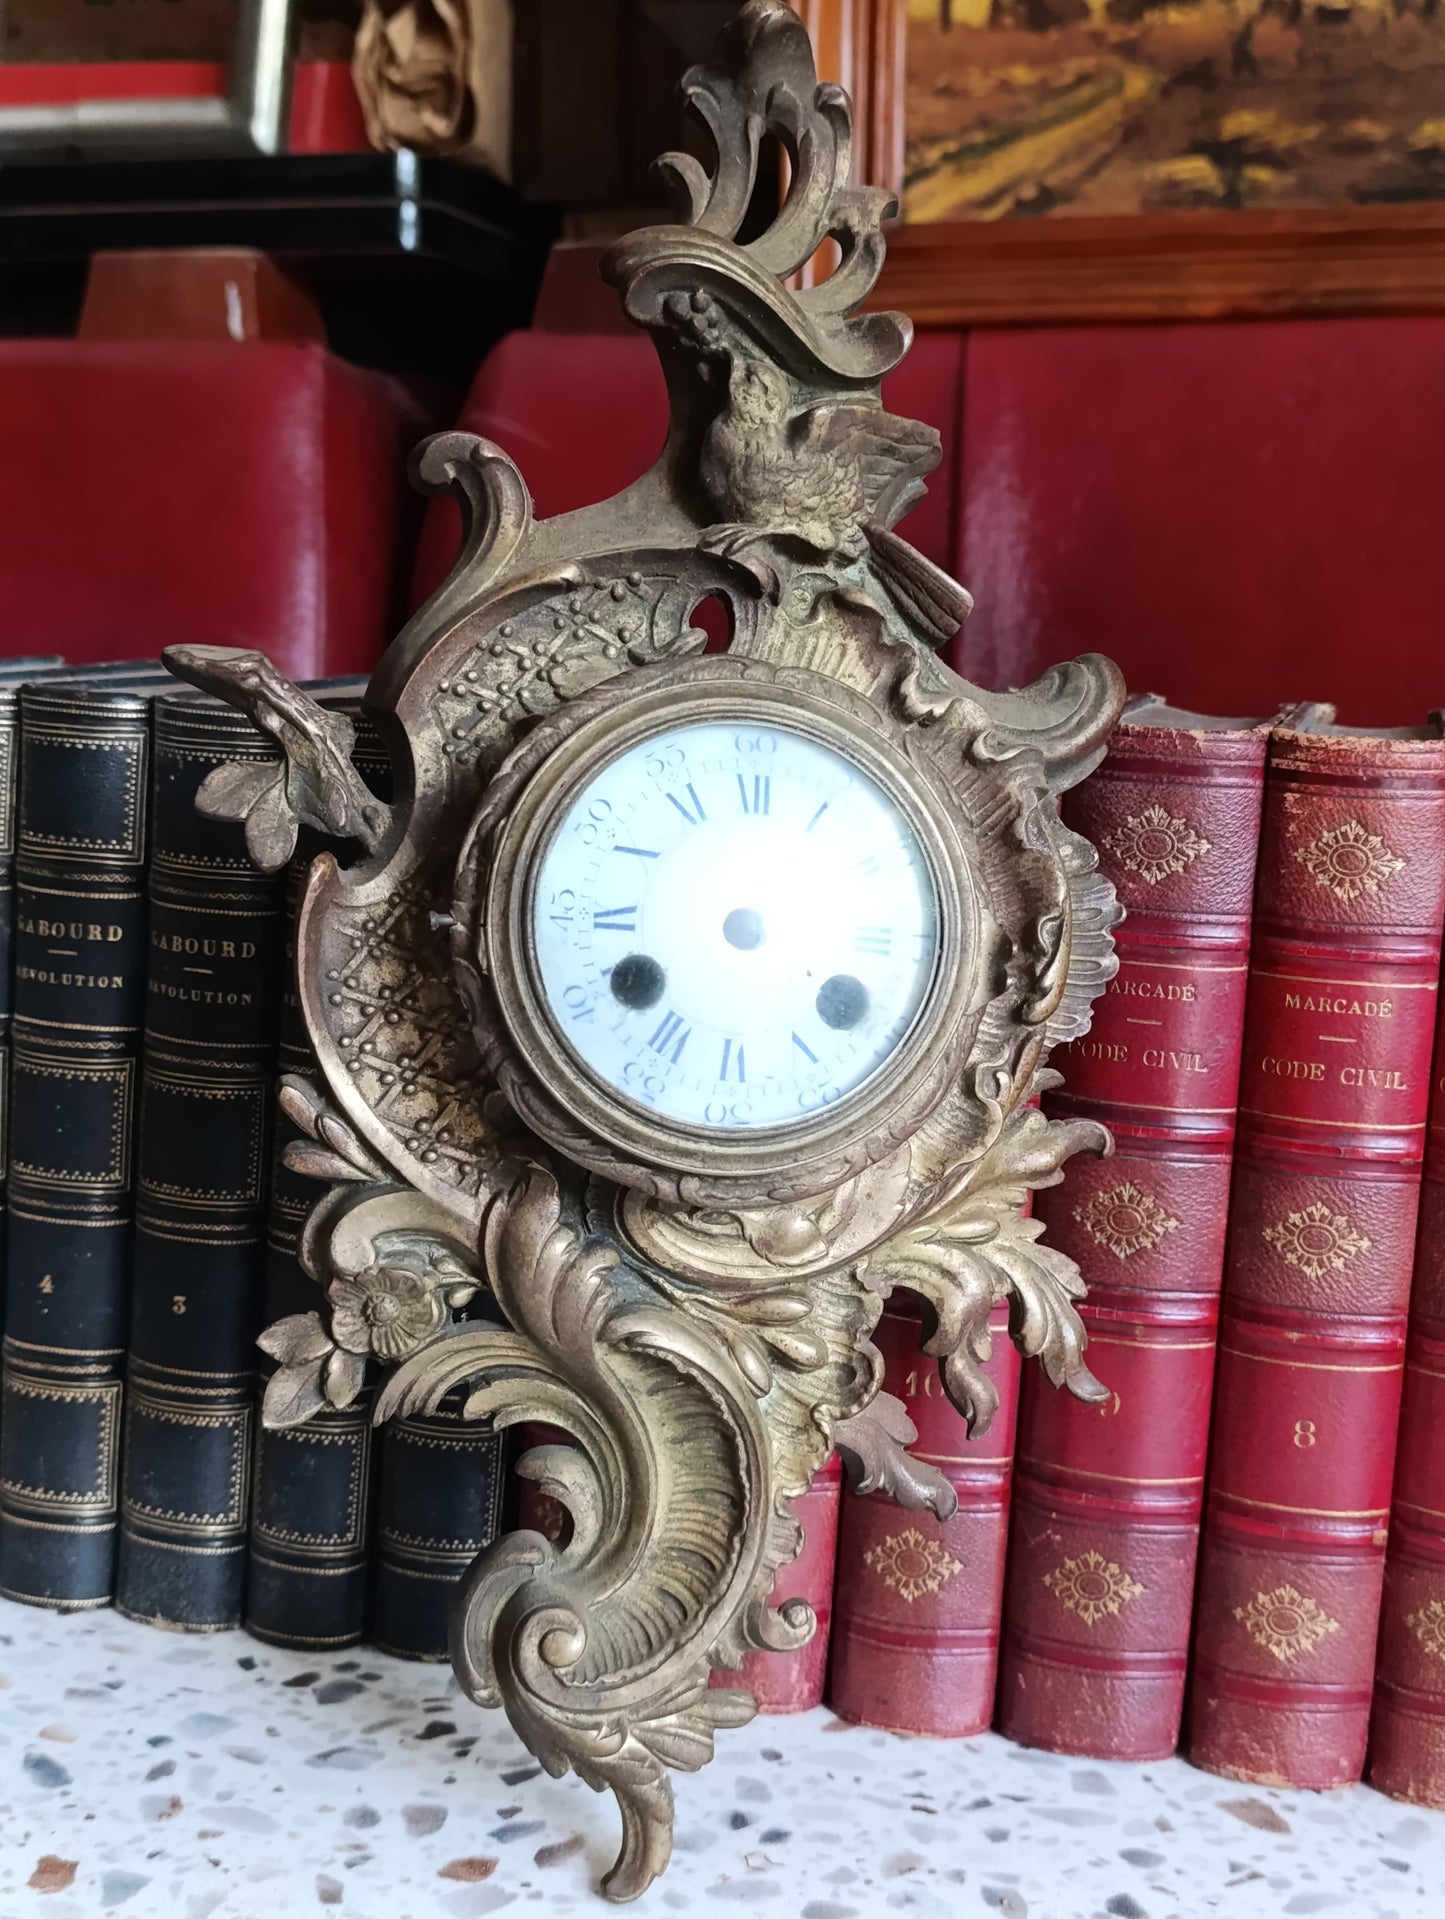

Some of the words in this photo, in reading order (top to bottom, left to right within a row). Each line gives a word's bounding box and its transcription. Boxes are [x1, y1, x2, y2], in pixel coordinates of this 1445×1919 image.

[735, 735, 777, 753] 60
[645, 743, 686, 777] 55
[573, 798, 612, 845] 50
[549, 888, 576, 932] 45
[17, 914, 124, 943] GABOURD
[152, 930, 257, 959] GABOURD
[1110, 980, 1197, 1001] ARCADÉ
[1285, 993, 1394, 1018] MARCADÉ
[1143, 1049, 1209, 1074] CIVIL
[1261, 1056, 1325, 1082] CODE
[1340, 1067, 1408, 1091] CIVIL
[37, 1274, 55, 1294] 4
[172, 1295, 188, 1315] 3
[1293, 1419, 1317, 1448] 8
